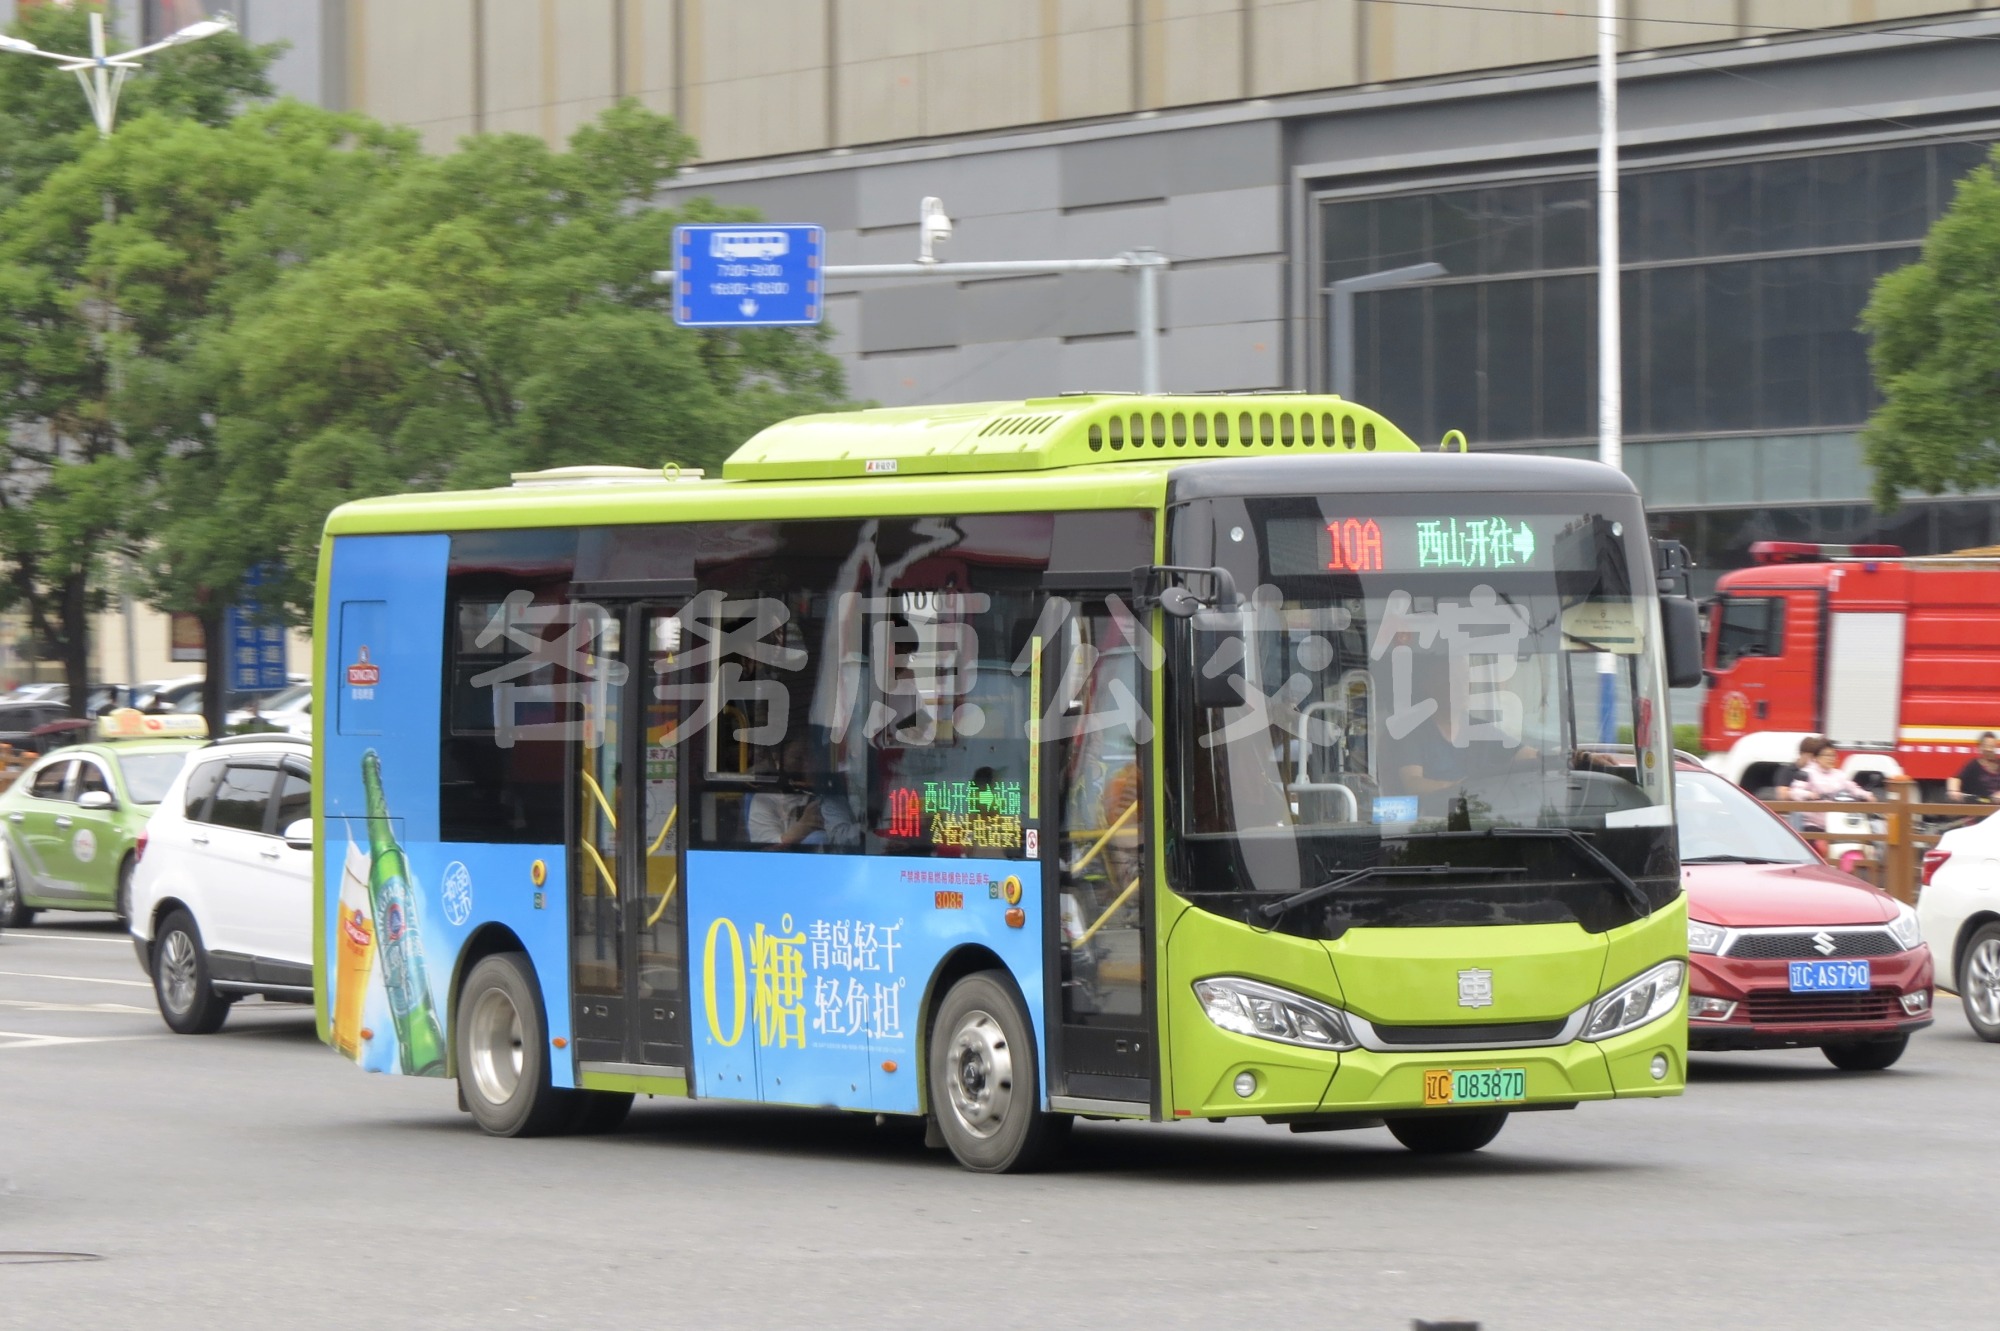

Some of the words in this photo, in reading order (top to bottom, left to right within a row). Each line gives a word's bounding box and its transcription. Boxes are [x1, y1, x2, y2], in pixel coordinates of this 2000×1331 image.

[1327, 518, 1383, 570] 10A
[1416, 517, 1515, 568] 西山开往
[889, 788, 920, 837] 10A
[923, 780, 980, 814] 西山开往
[935, 892, 963, 909] 3085
[812, 975, 904, 1039] 轻负担
